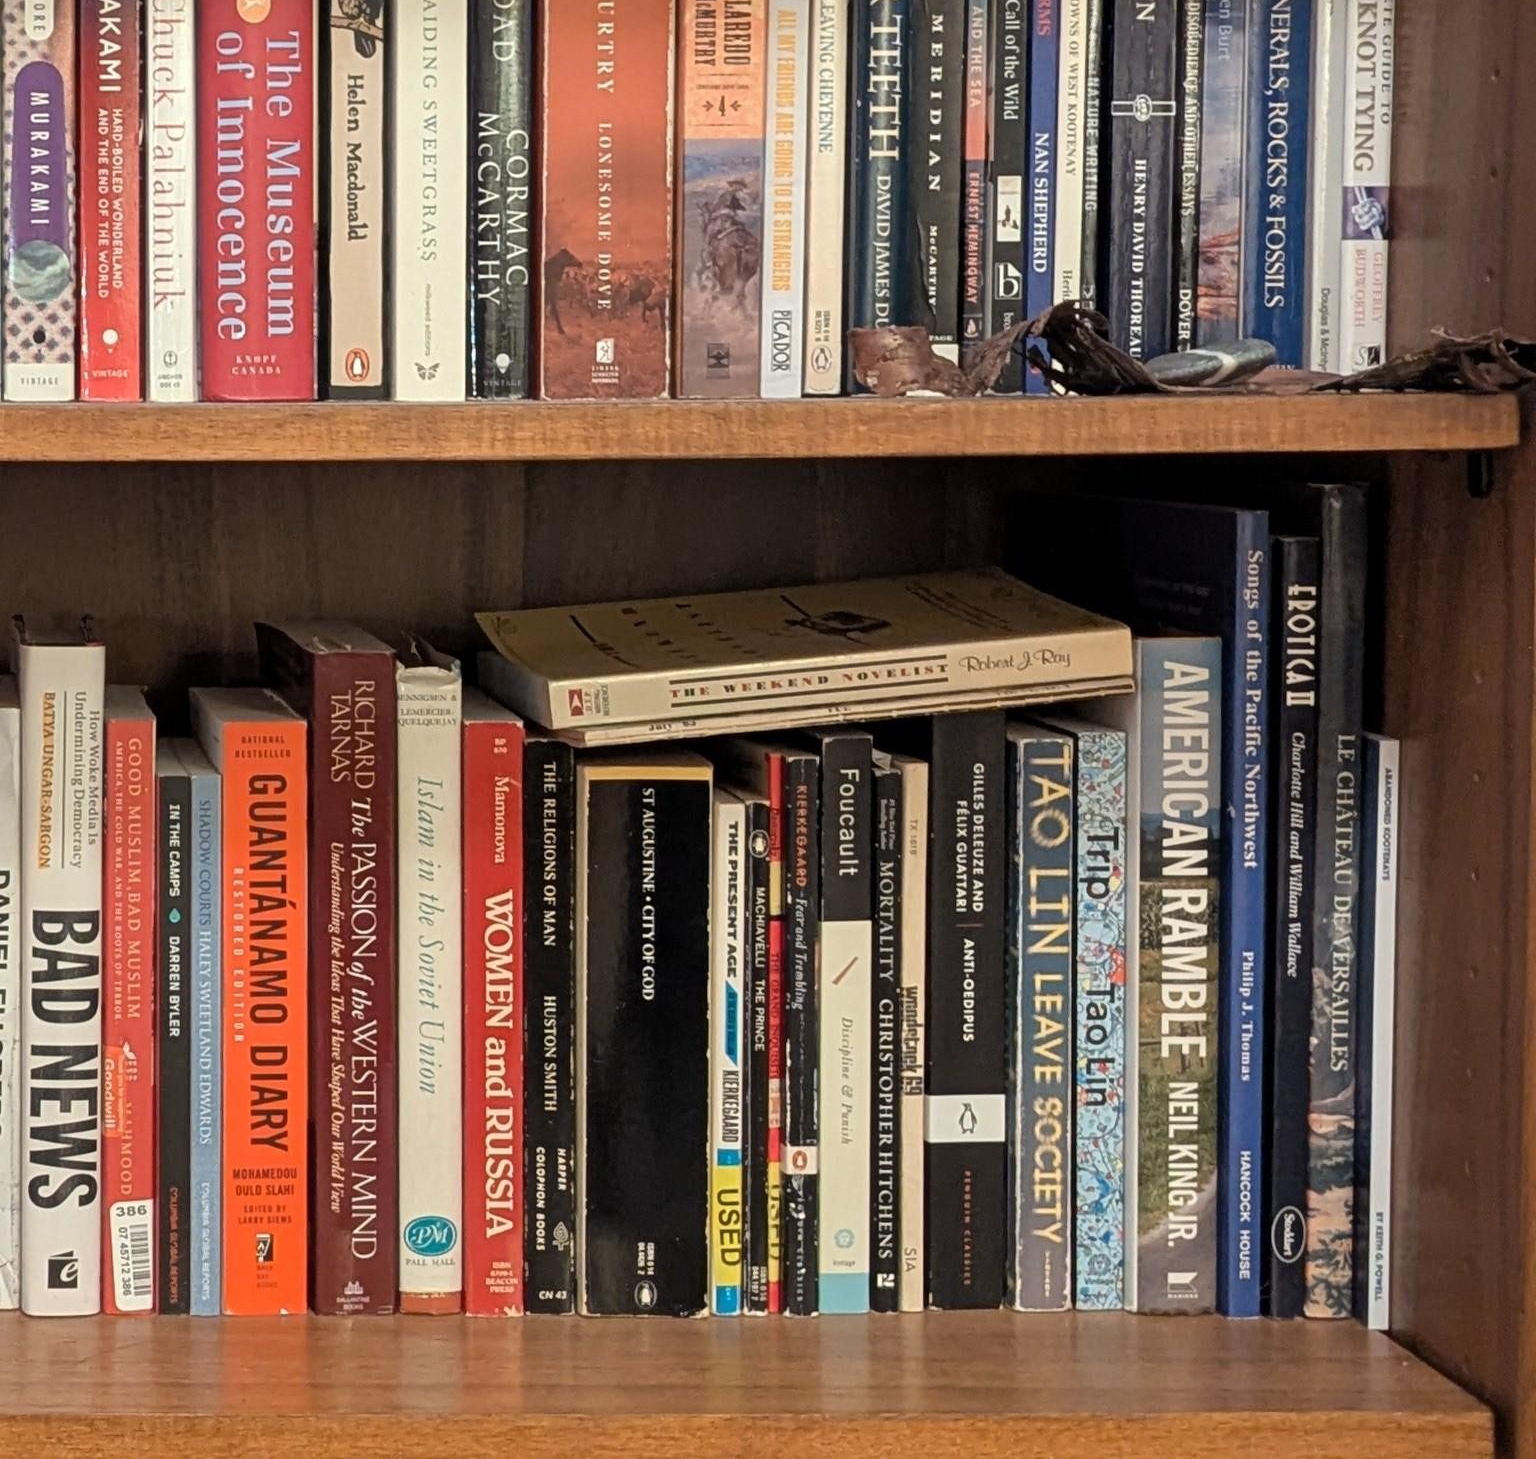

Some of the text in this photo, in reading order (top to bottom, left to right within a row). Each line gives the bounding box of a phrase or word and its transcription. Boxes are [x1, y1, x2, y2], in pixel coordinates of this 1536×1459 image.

[723, 0, 752, 67] LAREDO
[867, 17, 903, 161] TEETH
[29, 91, 52, 227] MURAKAMI
[214, 31, 253, 341] of Innocence
[265, 30, 302, 338] The Museum
[344, 74, 365, 242] Helen Macdonald
[1352, 82, 1376, 171] TYING
[231, 366, 281, 375] CANADA
[235, 354, 278, 364] KNOPF
[839, 768, 861, 877] Foucault
[1160, 659, 1211, 1060] AMERICAN RAMBLE
[248, 773, 296, 1154] GUANTÁNAMO DIARY
[27, 908, 100, 1210] BAD NEWS
[484, 889, 516, 1239] WOMEN and RUSSIA
[116, 1205, 147, 1217] 386
[232, 1168, 298, 1179] MOHAMEDOU
[235, 1184, 295, 1195] OULD SLAHI
[718, 1187, 742, 1268] USED
[1167, 1081, 1199, 1248] NEIL KING JR.
[1239, 1150, 1251, 1280] HANCOCK HOUSE
